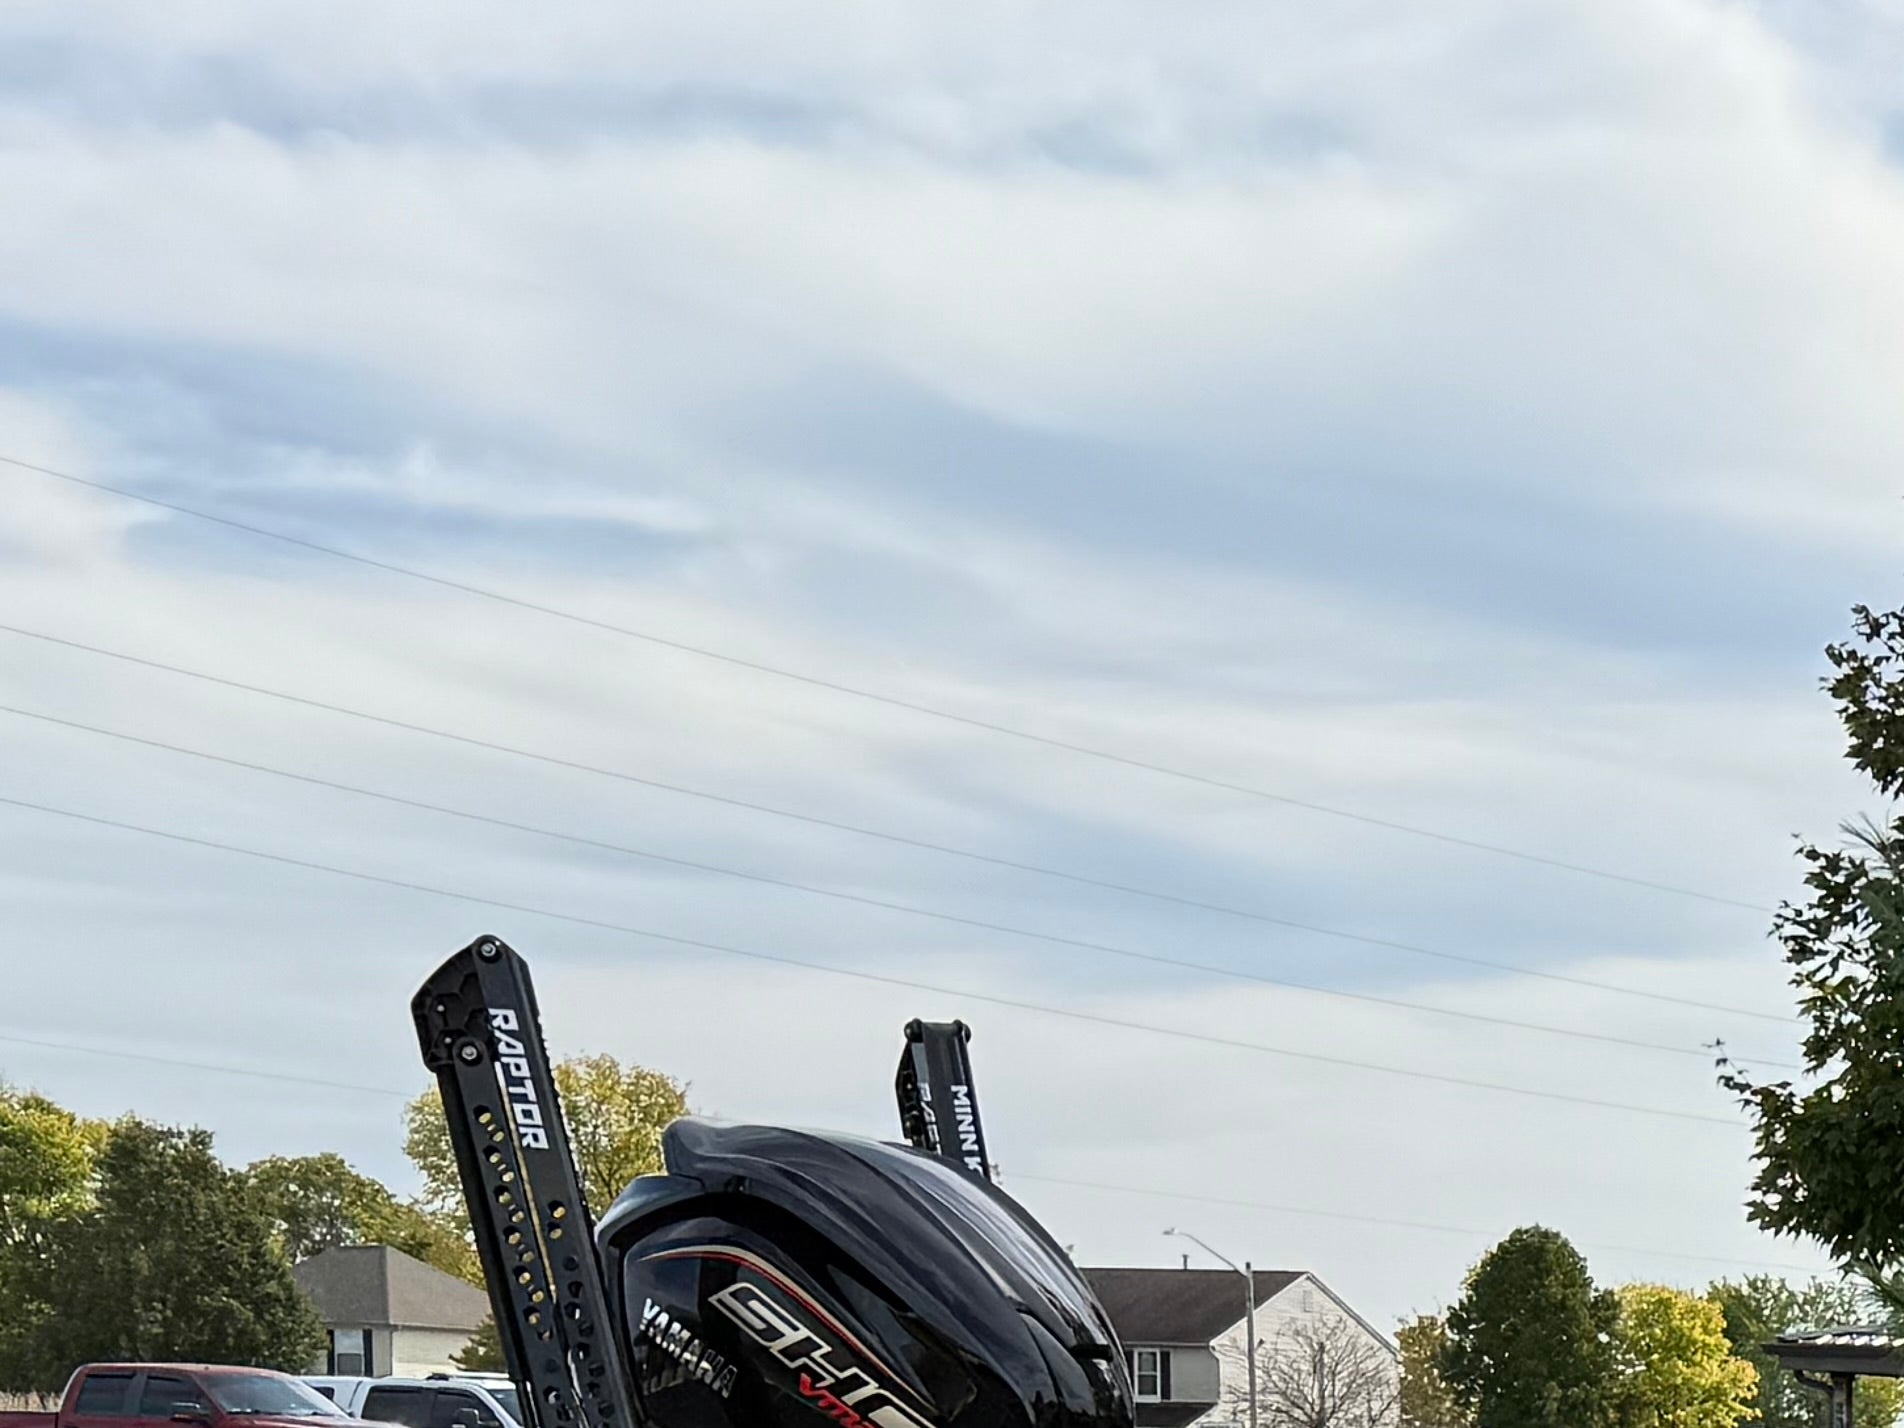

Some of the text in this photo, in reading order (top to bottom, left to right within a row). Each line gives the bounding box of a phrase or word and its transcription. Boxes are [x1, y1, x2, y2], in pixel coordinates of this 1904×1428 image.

[488, 1008, 549, 1149] RAPTOR
[951, 1085, 985, 1179] MINN K
[639, 1298, 737, 1398] YAMAHA
